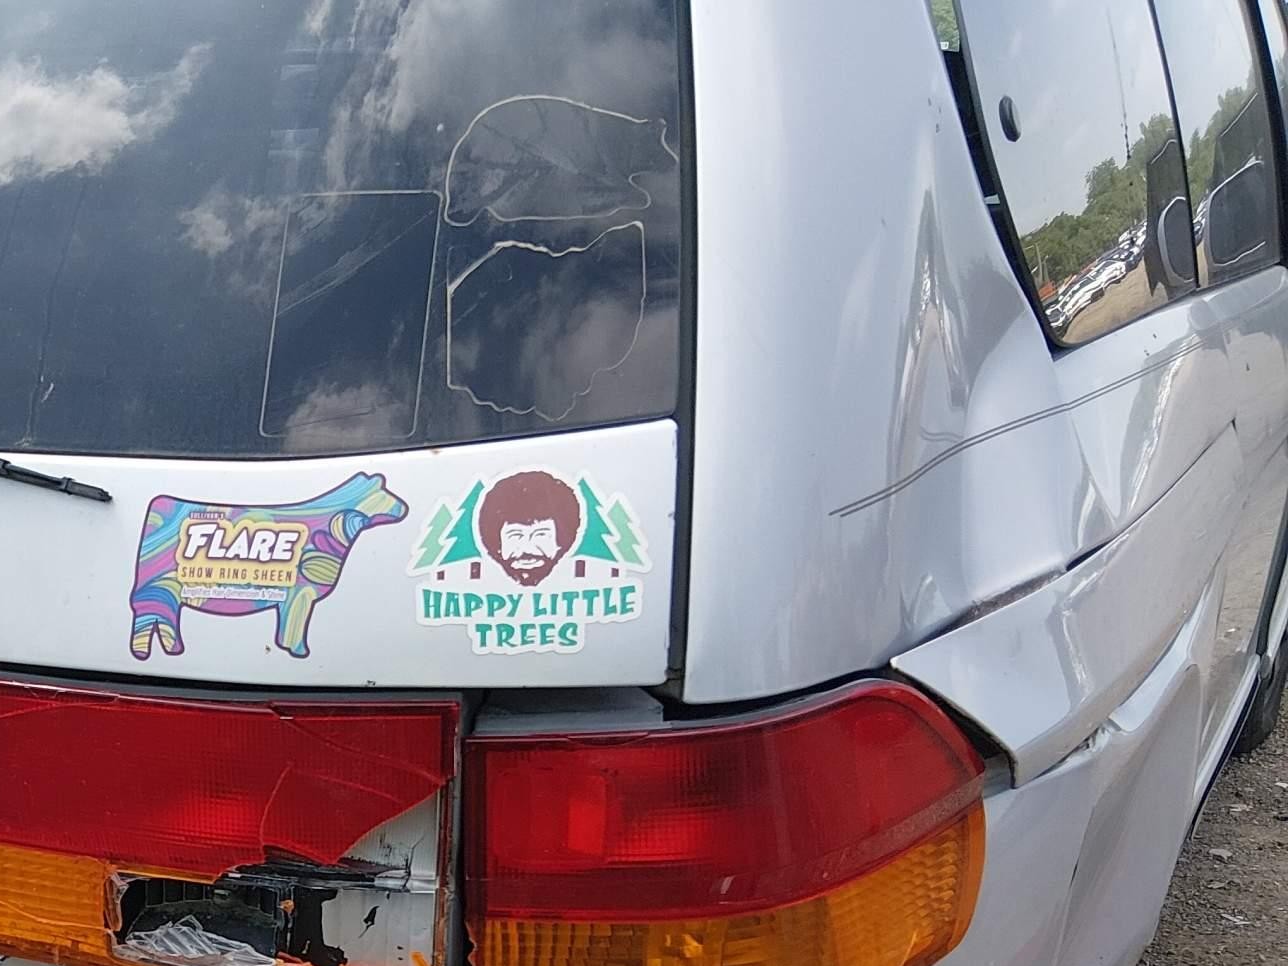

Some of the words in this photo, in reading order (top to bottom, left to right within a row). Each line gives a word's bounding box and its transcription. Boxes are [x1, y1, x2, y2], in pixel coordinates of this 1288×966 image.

[184, 523, 299, 562] FLARE
[181, 566, 213, 578] SHOW
[219, 569, 247, 580] RING
[253, 569, 292, 582] SHEEN
[422, 588, 523, 618] HAPPY
[532, 585, 636, 617] LITTLE
[475, 623, 579, 647] TREES
